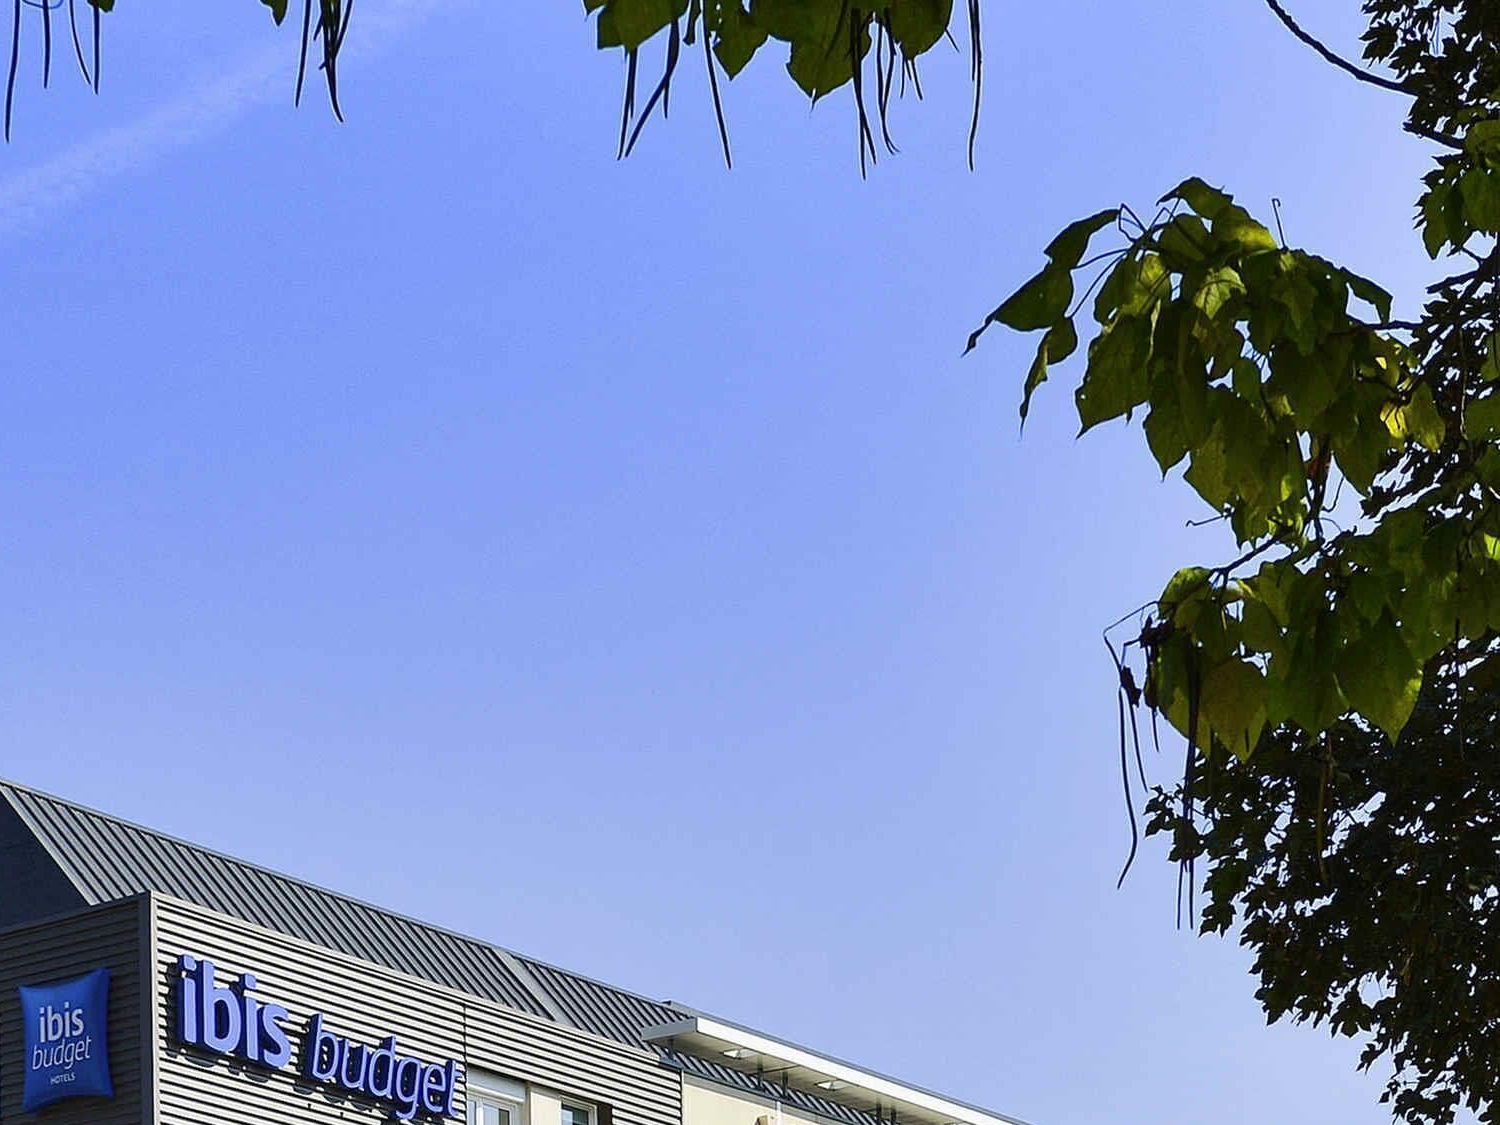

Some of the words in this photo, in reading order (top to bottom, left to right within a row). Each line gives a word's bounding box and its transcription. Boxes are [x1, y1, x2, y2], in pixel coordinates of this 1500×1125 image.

[39, 1001, 85, 1043] ibis
[177, 953, 292, 1069] ibis
[308, 1012, 463, 1120] budget
[31, 1035, 93, 1071] budget
[50, 1071, 77, 1085] HOTELS
